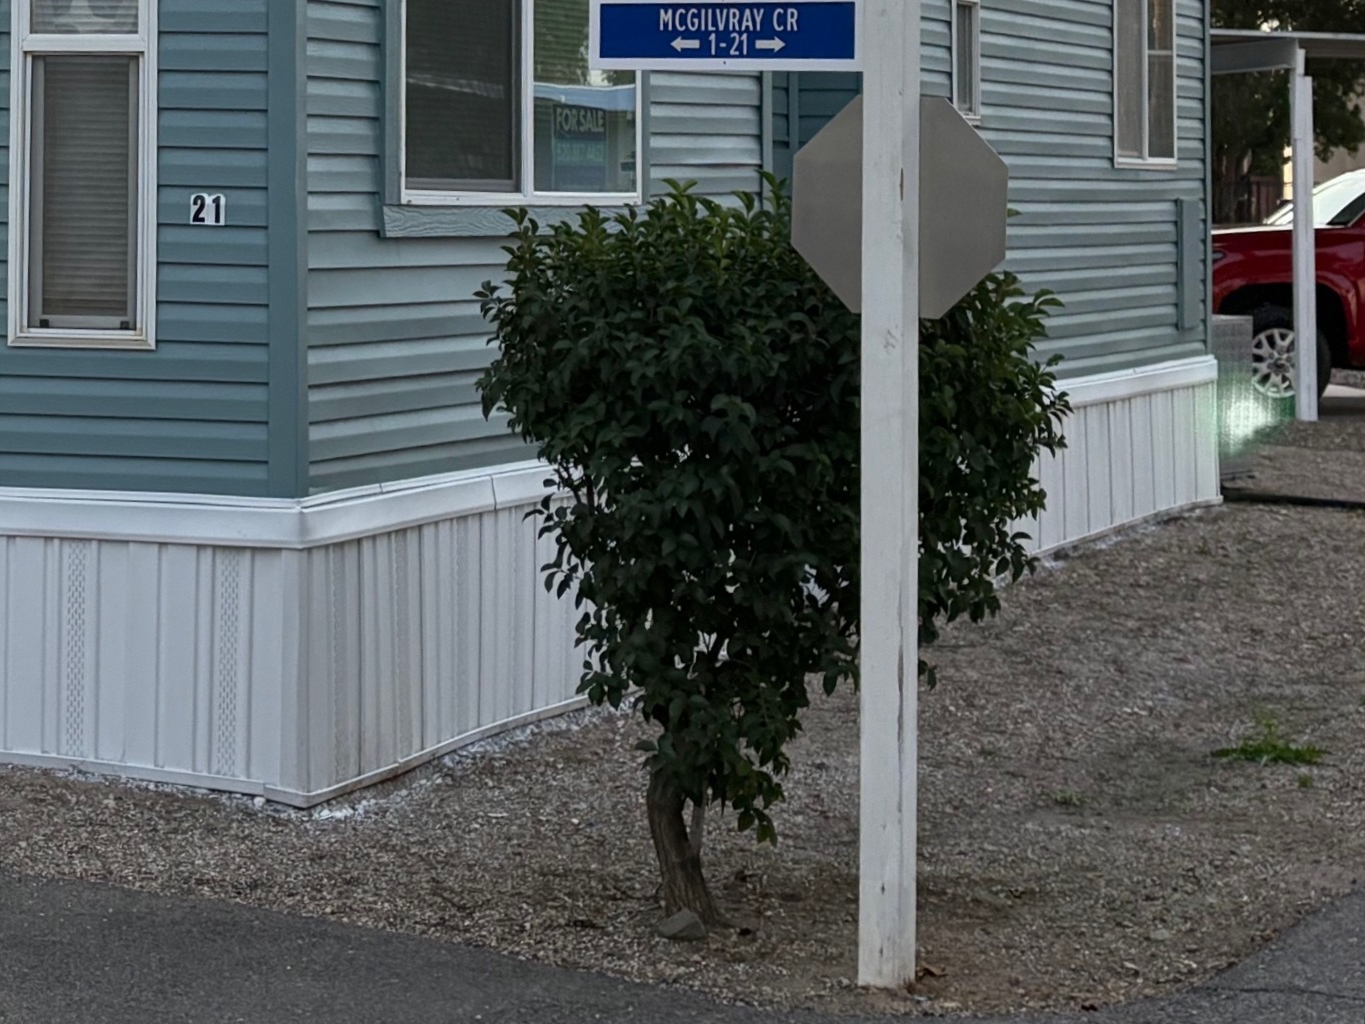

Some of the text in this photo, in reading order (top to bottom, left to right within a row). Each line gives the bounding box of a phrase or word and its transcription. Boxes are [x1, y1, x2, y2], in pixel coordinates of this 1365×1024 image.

[659, 7, 798, 32] MCGILVRAY CR
[708, 32, 748, 56] 1-21
[556, 106, 605, 133] FOR SALE
[192, 194, 221, 224] 21
